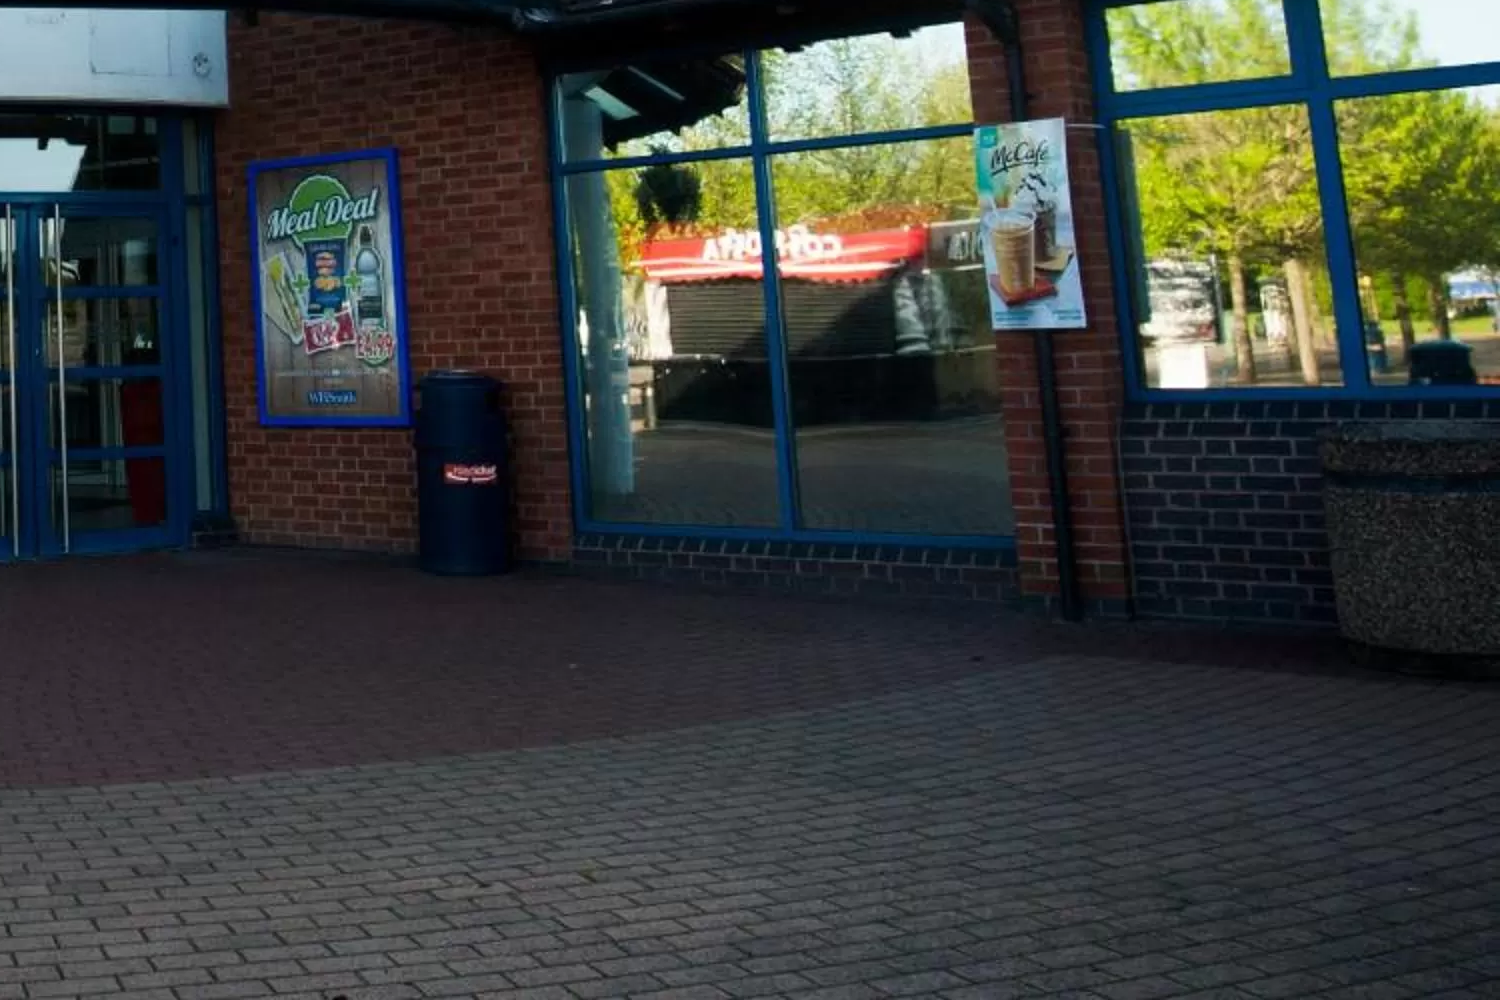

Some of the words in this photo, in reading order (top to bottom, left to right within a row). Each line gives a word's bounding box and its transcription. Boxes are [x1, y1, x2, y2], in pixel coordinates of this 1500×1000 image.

[990, 139, 1049, 171] McCafé
[267, 202, 320, 239] Meal
[324, 187, 379, 225] Deal
